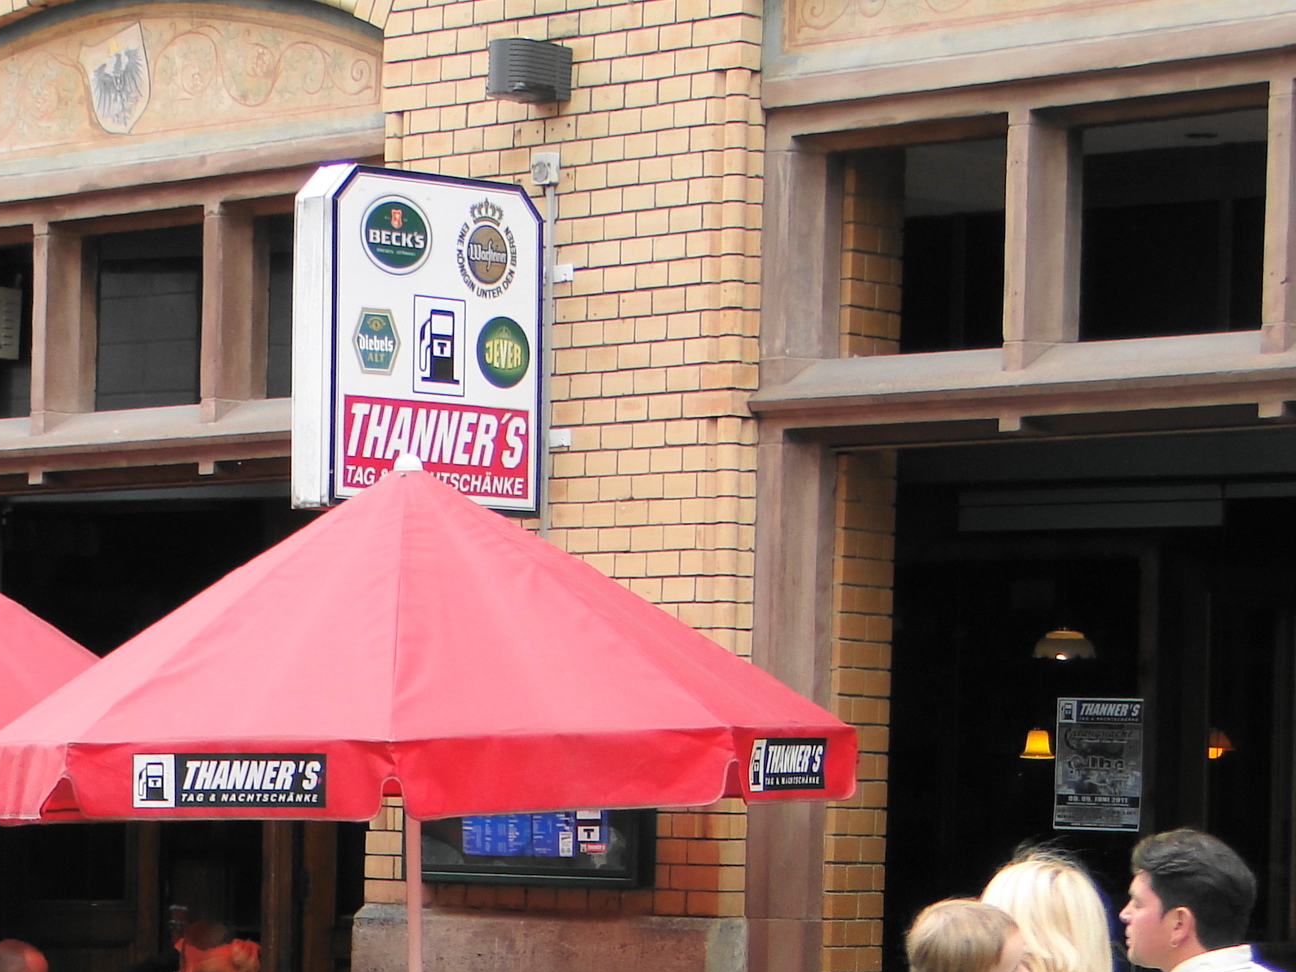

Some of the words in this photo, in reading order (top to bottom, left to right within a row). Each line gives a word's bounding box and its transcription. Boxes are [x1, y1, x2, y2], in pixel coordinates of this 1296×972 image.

[369, 229, 424, 249] BECK'S
[456, 221, 470, 247] EINE
[476, 286, 503, 299] UNTER
[501, 268, 515, 291] DEN
[358, 333, 394, 352] Diebels
[366, 352, 385, 364] ALT
[484, 338, 523, 370] JEVER
[347, 402, 527, 469] THANNER'S
[345, 464, 376, 486] TAG
[1079, 703, 1141, 717] THANNER'S
[765, 745, 824, 774] THANNER'S
[182, 760, 322, 791] THANNER'S
[181, 793, 204, 803] TAG
[209, 793, 216, 803] &
[221, 792, 319, 804] NACHTSCHÄNKE
